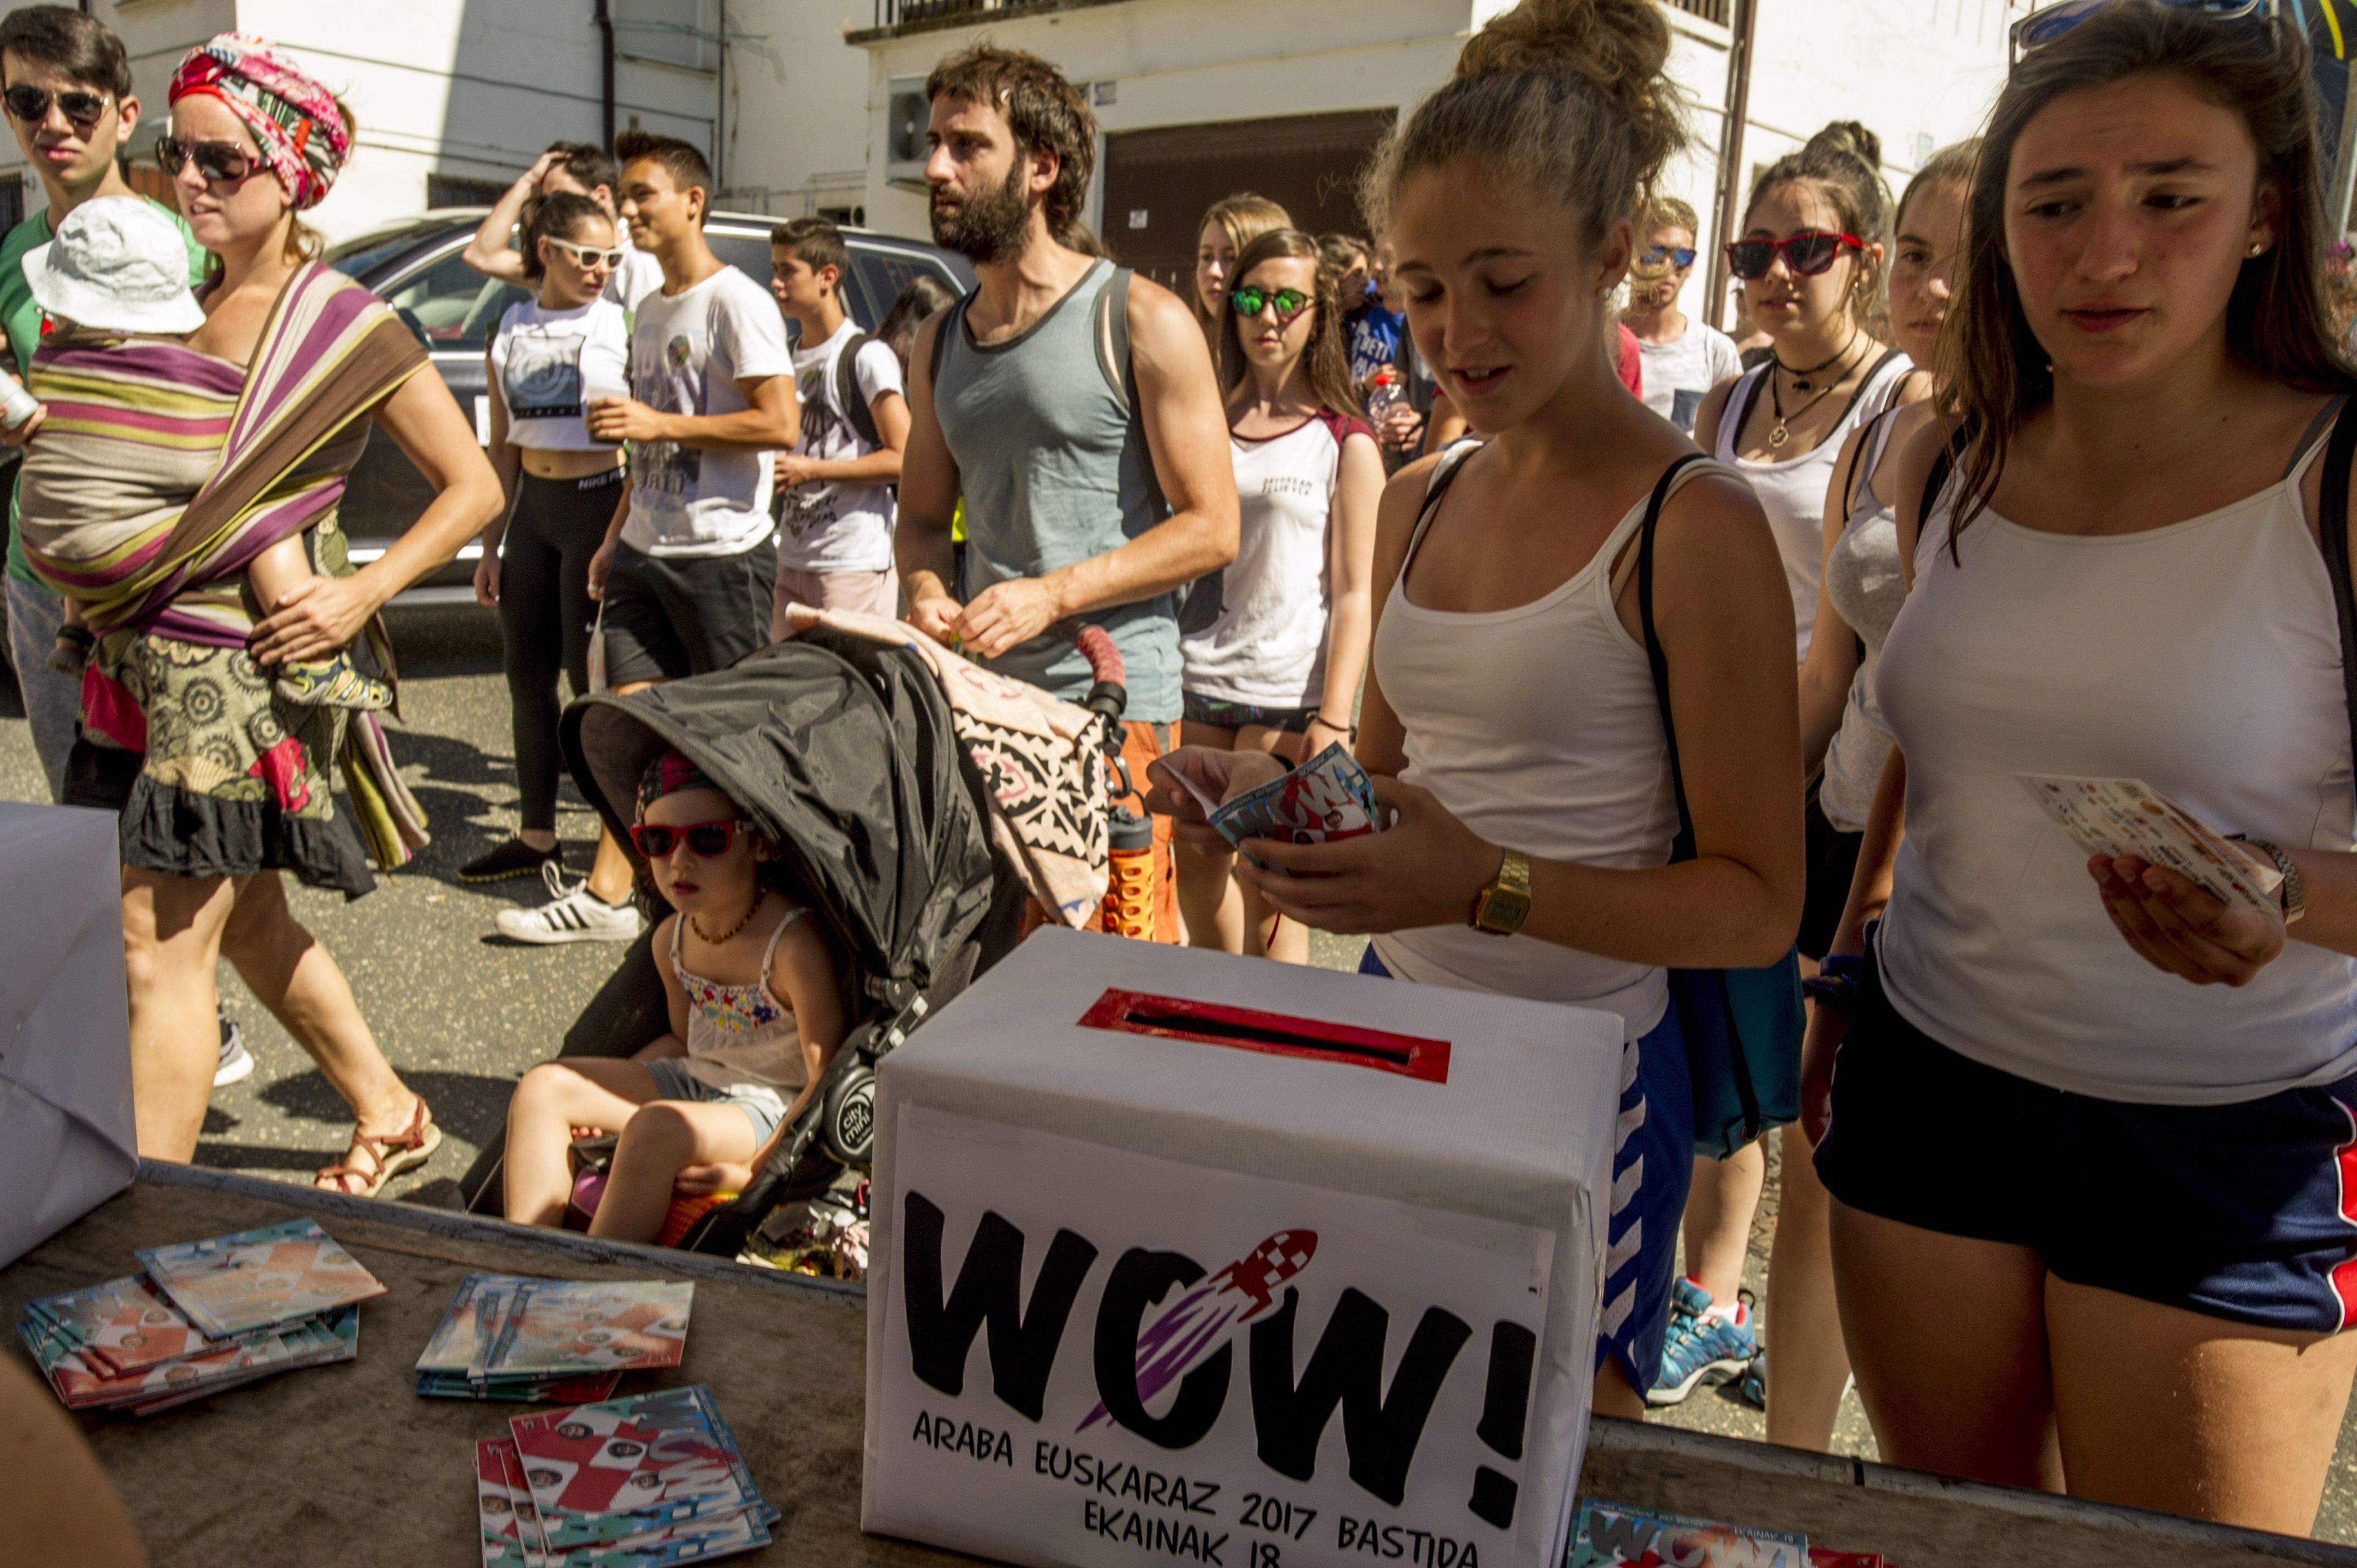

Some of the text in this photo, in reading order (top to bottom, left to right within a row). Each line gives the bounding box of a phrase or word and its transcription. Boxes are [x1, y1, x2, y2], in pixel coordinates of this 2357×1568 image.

[579, 473, 608, 489] NIKE
[843, 1103, 862, 1129] city
[845, 1108, 871, 1144] mini
[904, 1191, 1536, 1529] WOW!
[913, 1411, 1478, 1568] ARABA EUSKARAZ 2017 BASTIDA
[1084, 1499, 1281, 1568] EKAINAK 18
